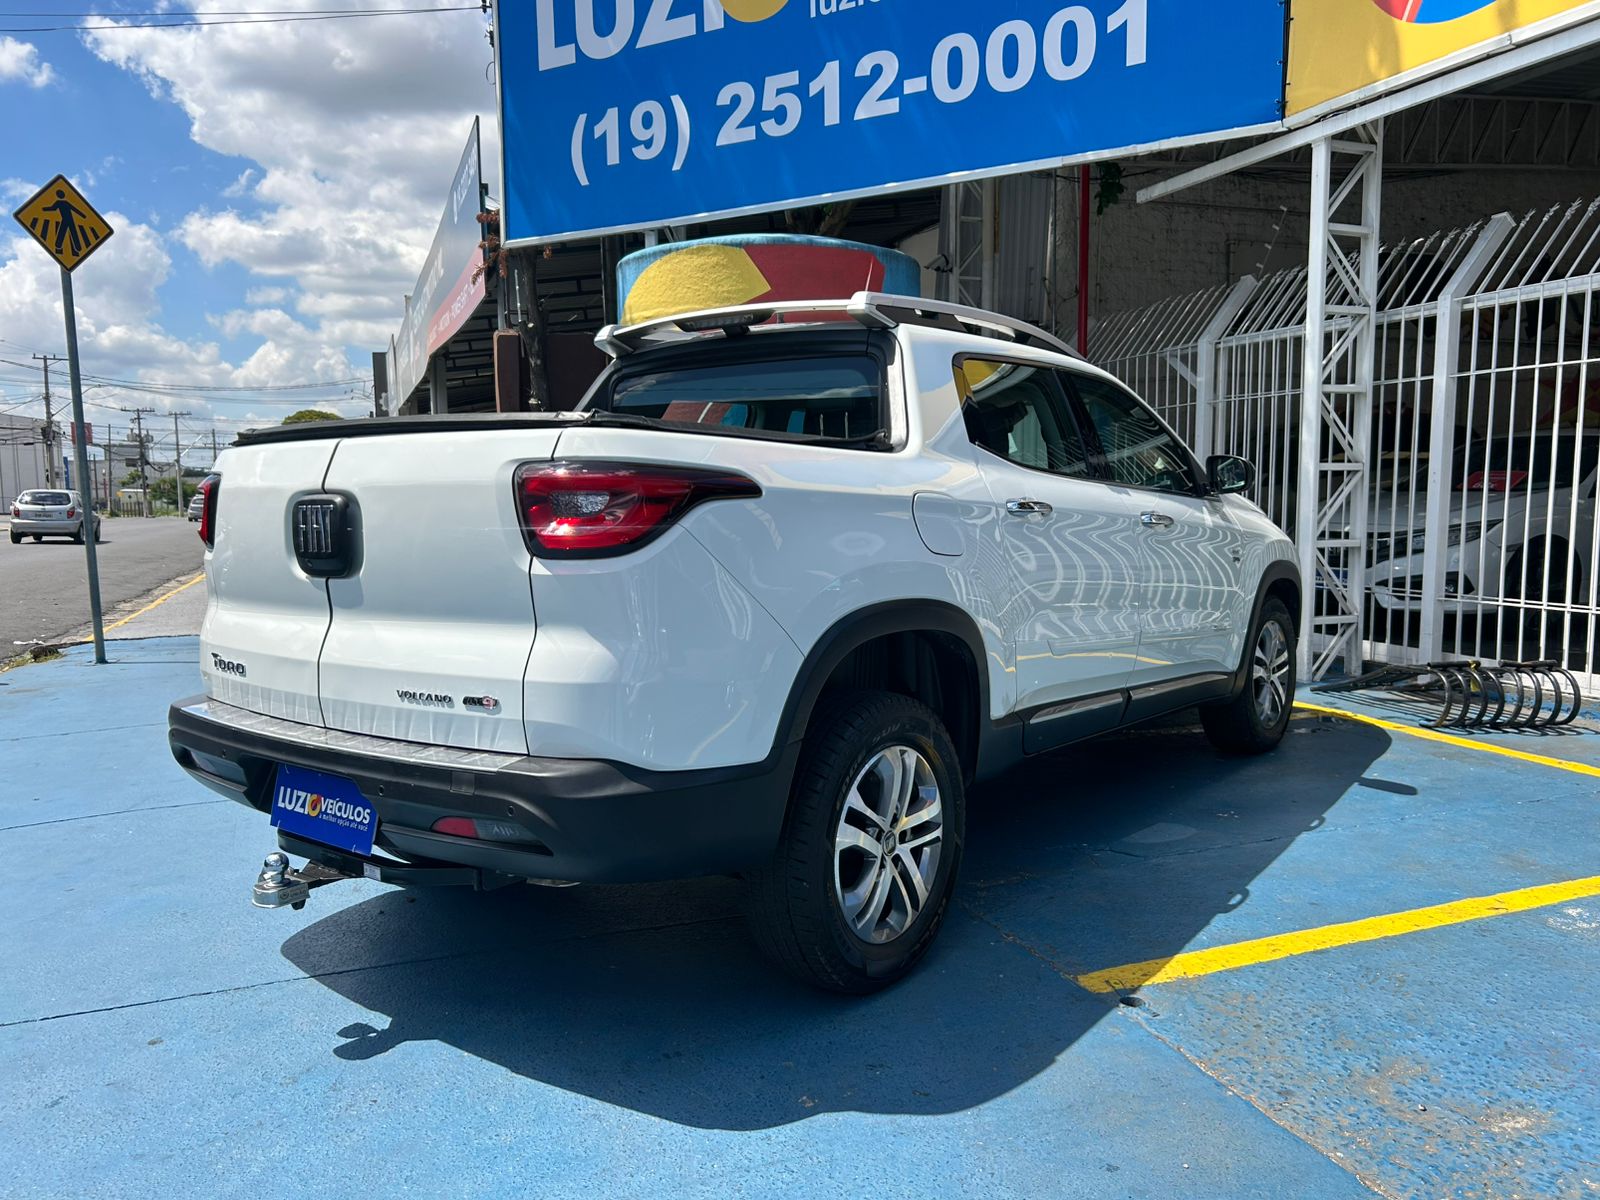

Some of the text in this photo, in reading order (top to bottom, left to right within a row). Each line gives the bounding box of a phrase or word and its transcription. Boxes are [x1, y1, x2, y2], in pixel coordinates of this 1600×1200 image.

[571, 94, 691, 186] (19)
[715, 0, 1148, 147] 2512-0001
[298, 504, 333, 553] FIAT
[211, 652, 245, 675] TORO
[396, 690, 452, 704] VOLCANO
